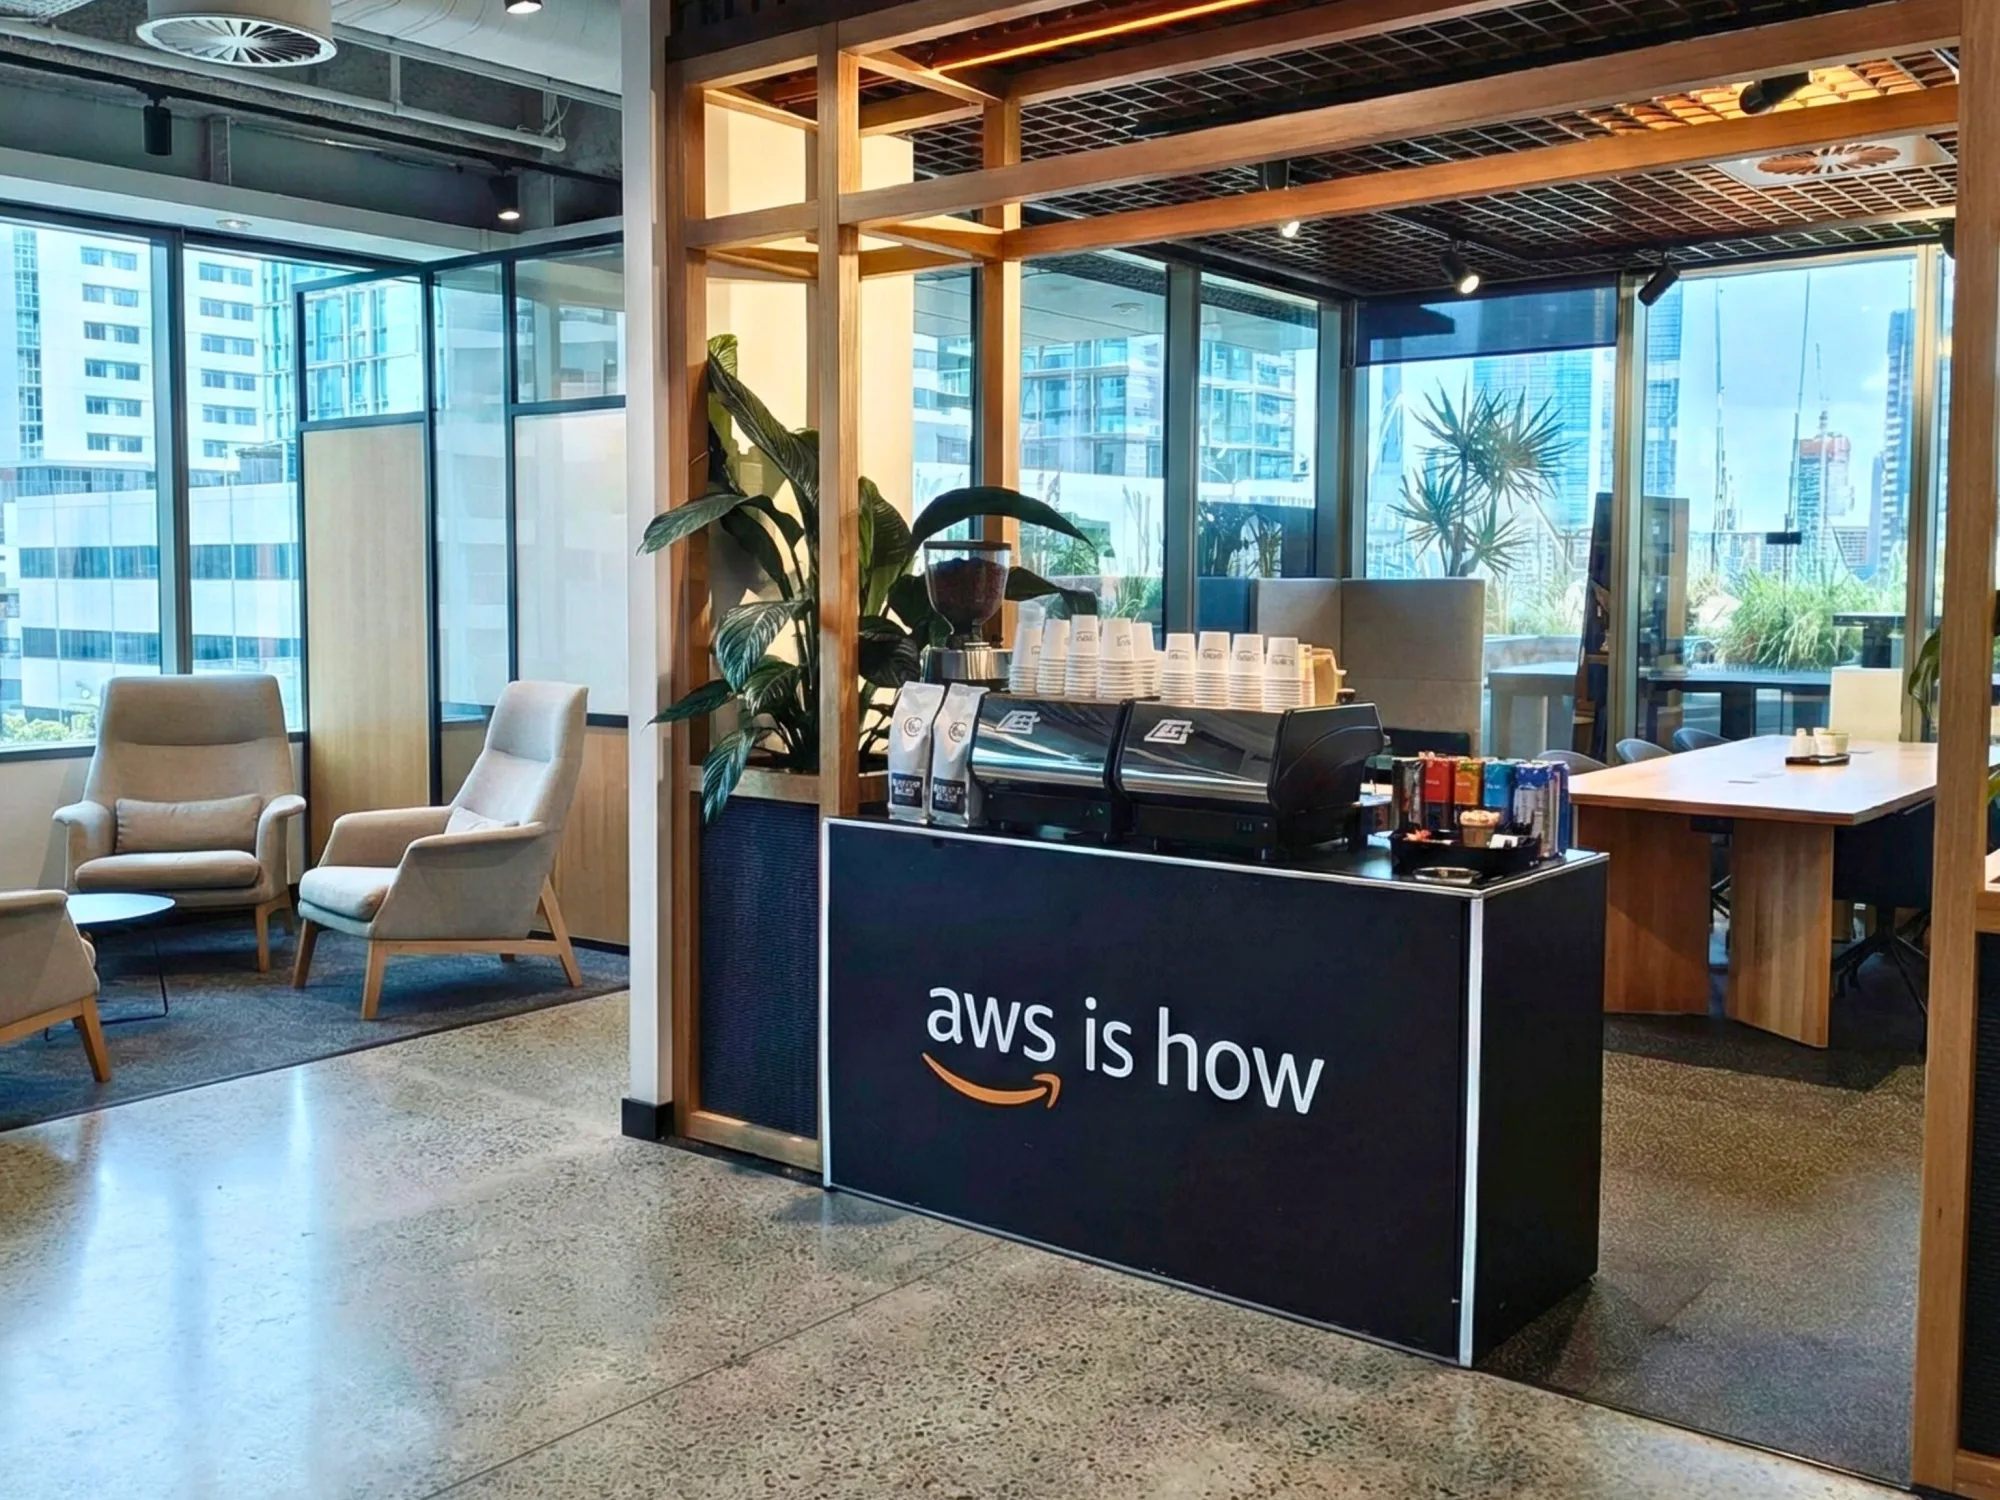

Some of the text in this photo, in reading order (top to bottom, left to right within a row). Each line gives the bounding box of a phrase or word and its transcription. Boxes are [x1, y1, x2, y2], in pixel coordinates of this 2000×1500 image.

[926, 986, 1325, 1115] aws is how
